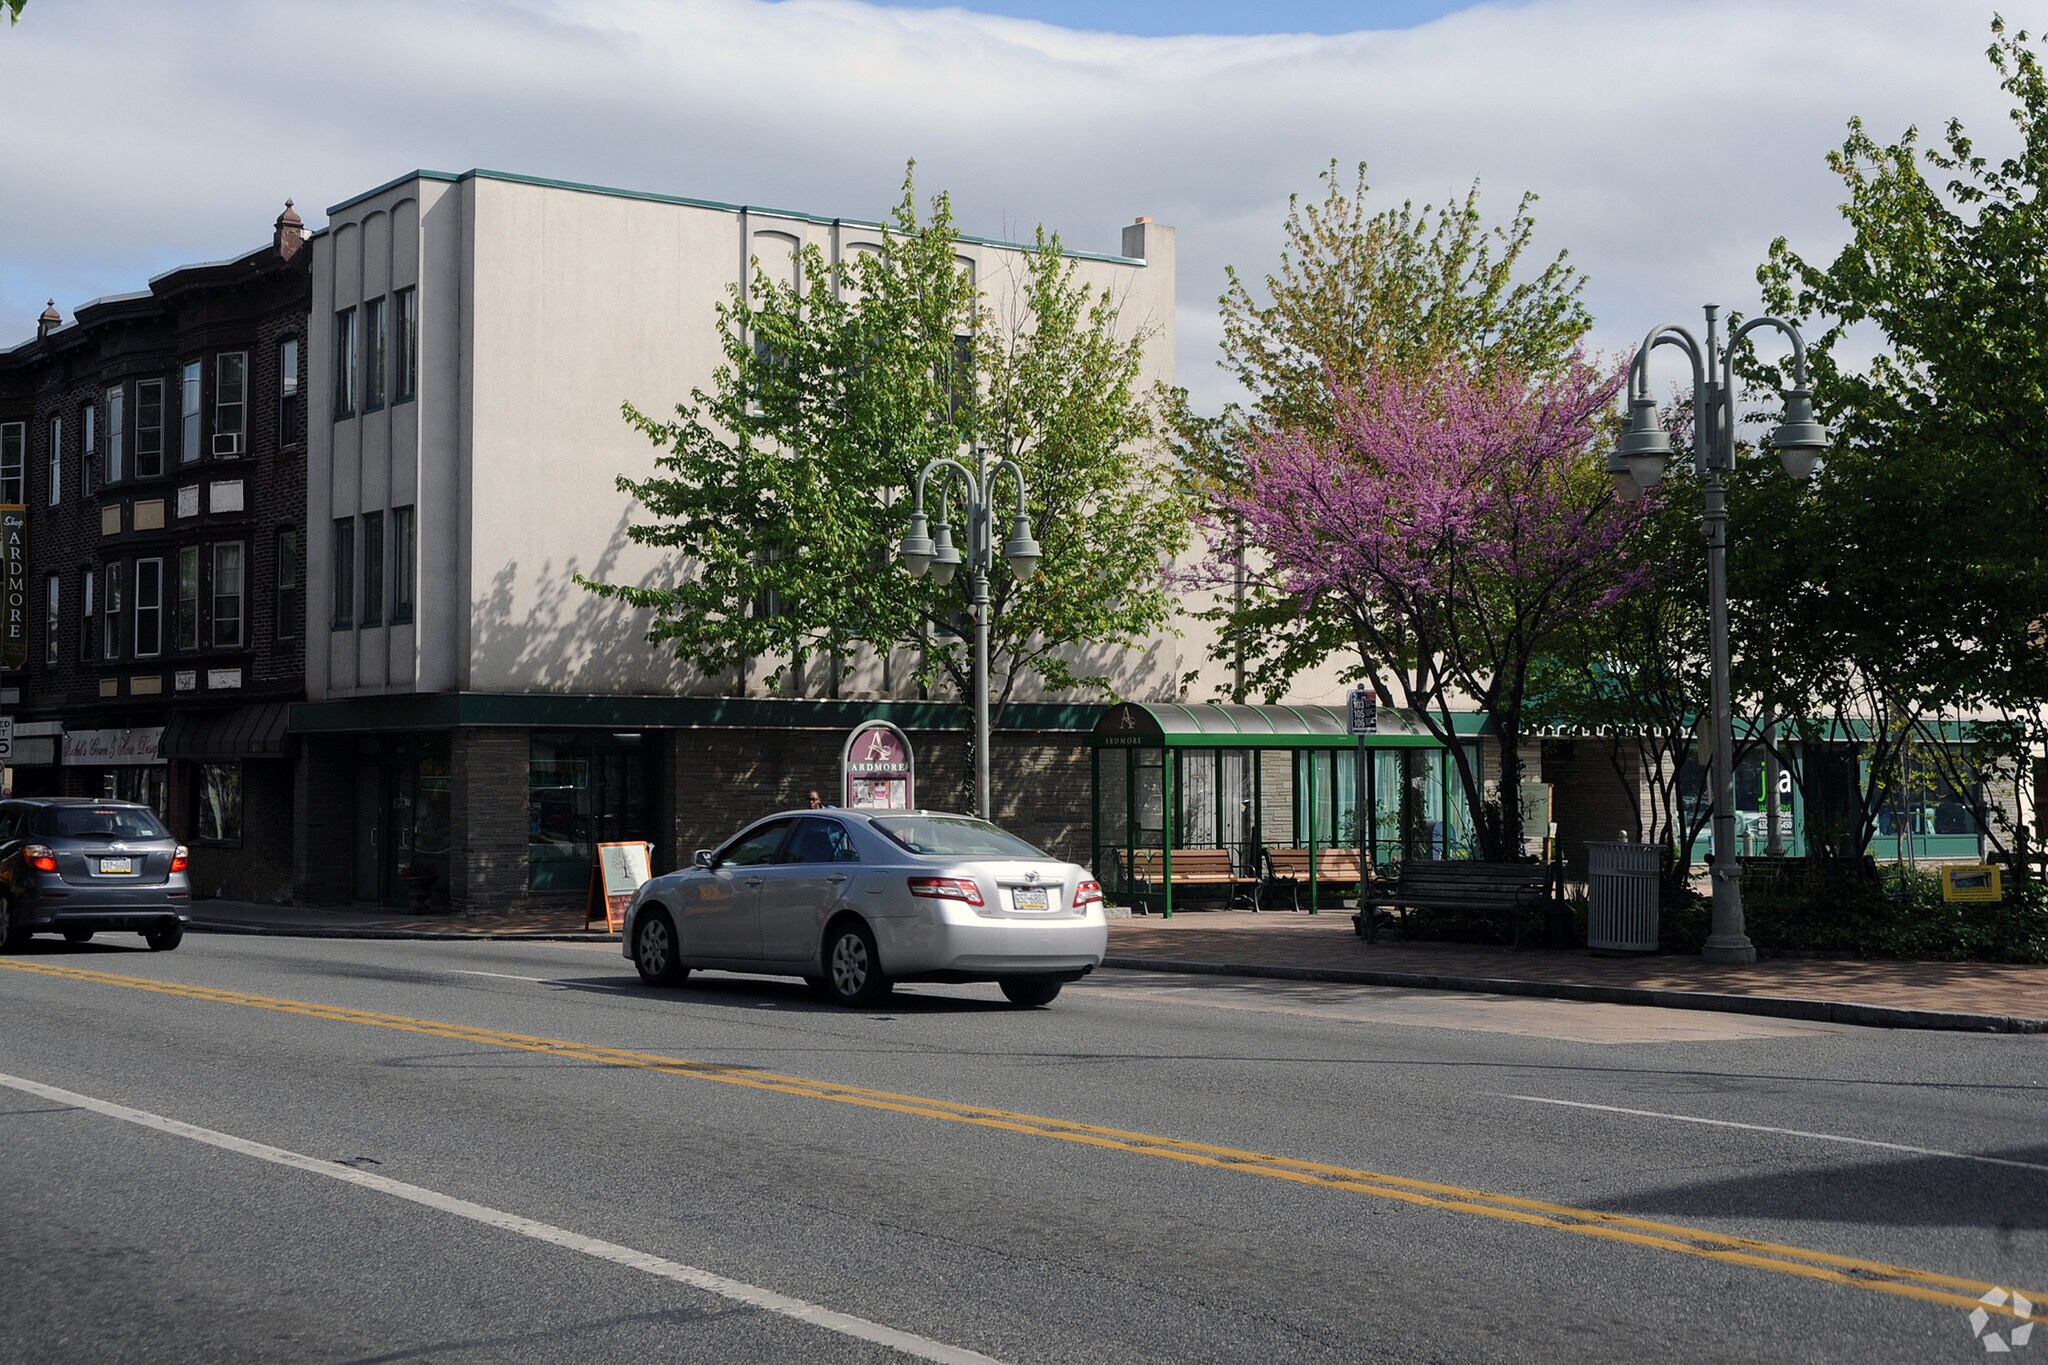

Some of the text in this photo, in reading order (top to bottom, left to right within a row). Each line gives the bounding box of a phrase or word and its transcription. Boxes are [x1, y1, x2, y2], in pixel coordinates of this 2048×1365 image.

[3, 515, 24, 528] Shop
[9, 532, 23, 638] ARDMORE
[1353, 701, 1364, 709] 103
[1353, 710, 1365, 718] 105
[1354, 719, 1365, 727] 106
[1104, 737, 1142, 745] ARDMORE
[851, 763, 905, 771] ARDMORE
